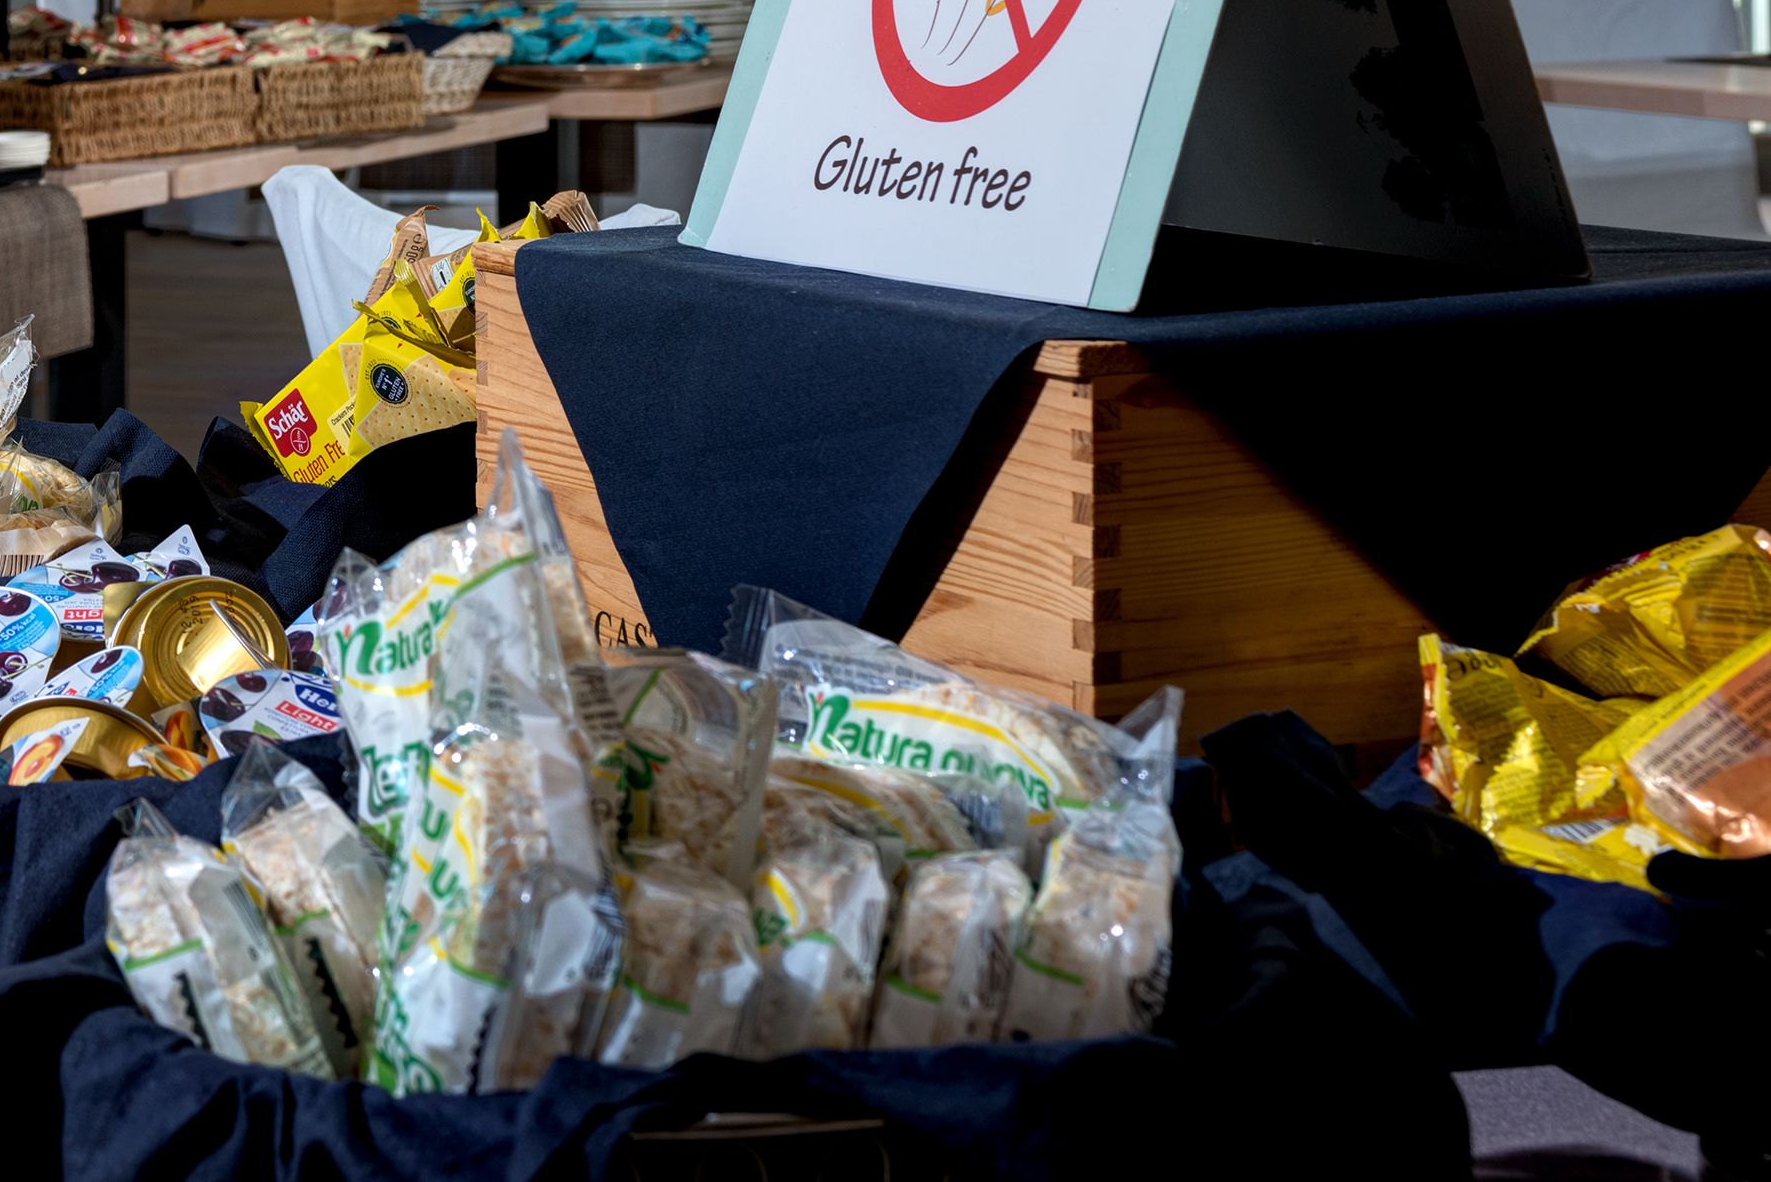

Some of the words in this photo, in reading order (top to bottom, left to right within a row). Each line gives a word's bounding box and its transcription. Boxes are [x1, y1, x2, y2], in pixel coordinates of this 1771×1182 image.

[813, 135, 944, 203] Gluten
[950, 146, 1032, 211] free
[268, 399, 310, 441] Schär
[293, 448, 328, 486] Gluten
[326, 439, 346, 464] Fre
[281, 704, 334, 730] Light
[299, 688, 338, 711] Her
